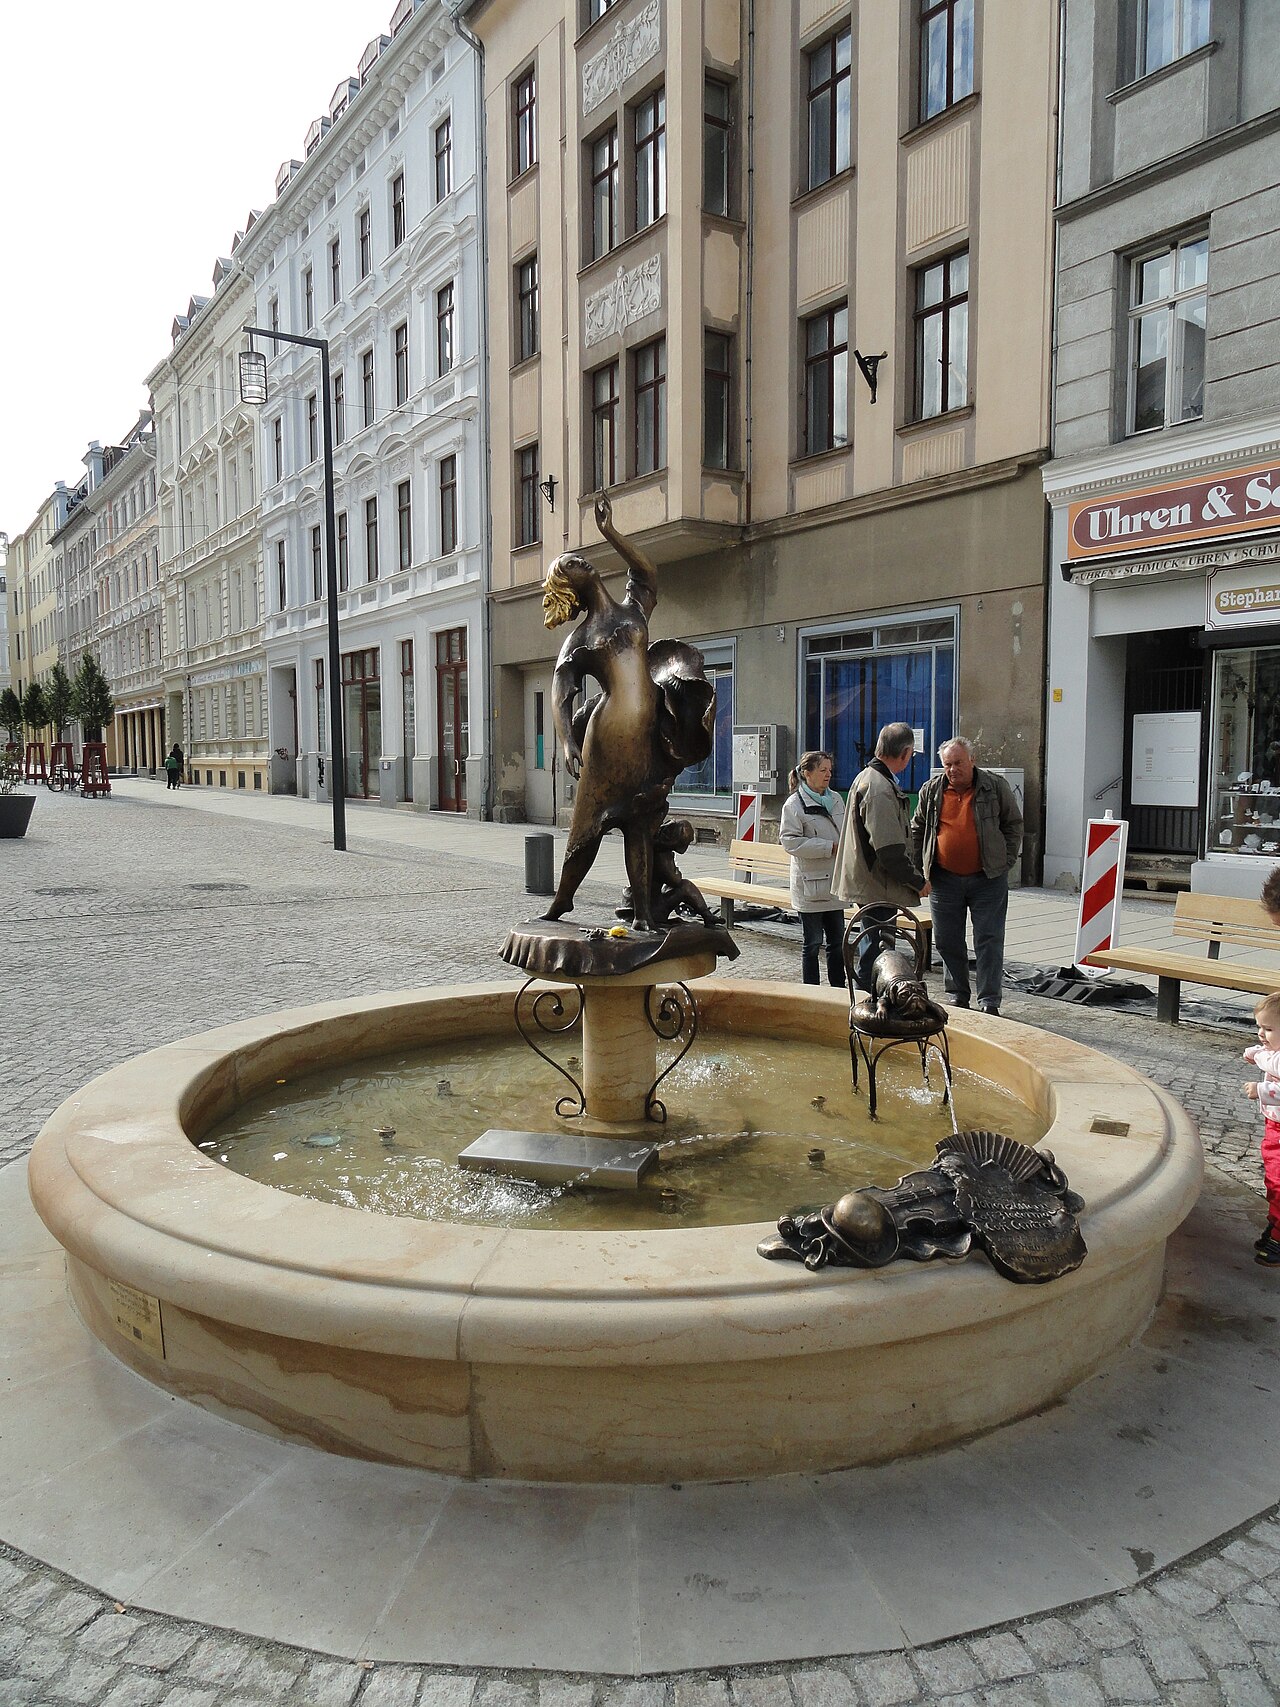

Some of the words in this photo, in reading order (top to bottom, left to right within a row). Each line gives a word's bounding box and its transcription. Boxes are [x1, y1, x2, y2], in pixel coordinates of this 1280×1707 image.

[1088, 503, 1193, 541] Uhren
[1202, 485, 1236, 521] &
[1080, 568, 1116, 581] UHREN
[1123, 559, 1180, 575] SCHMUCK
[1188, 551, 1231, 566] UHREN
